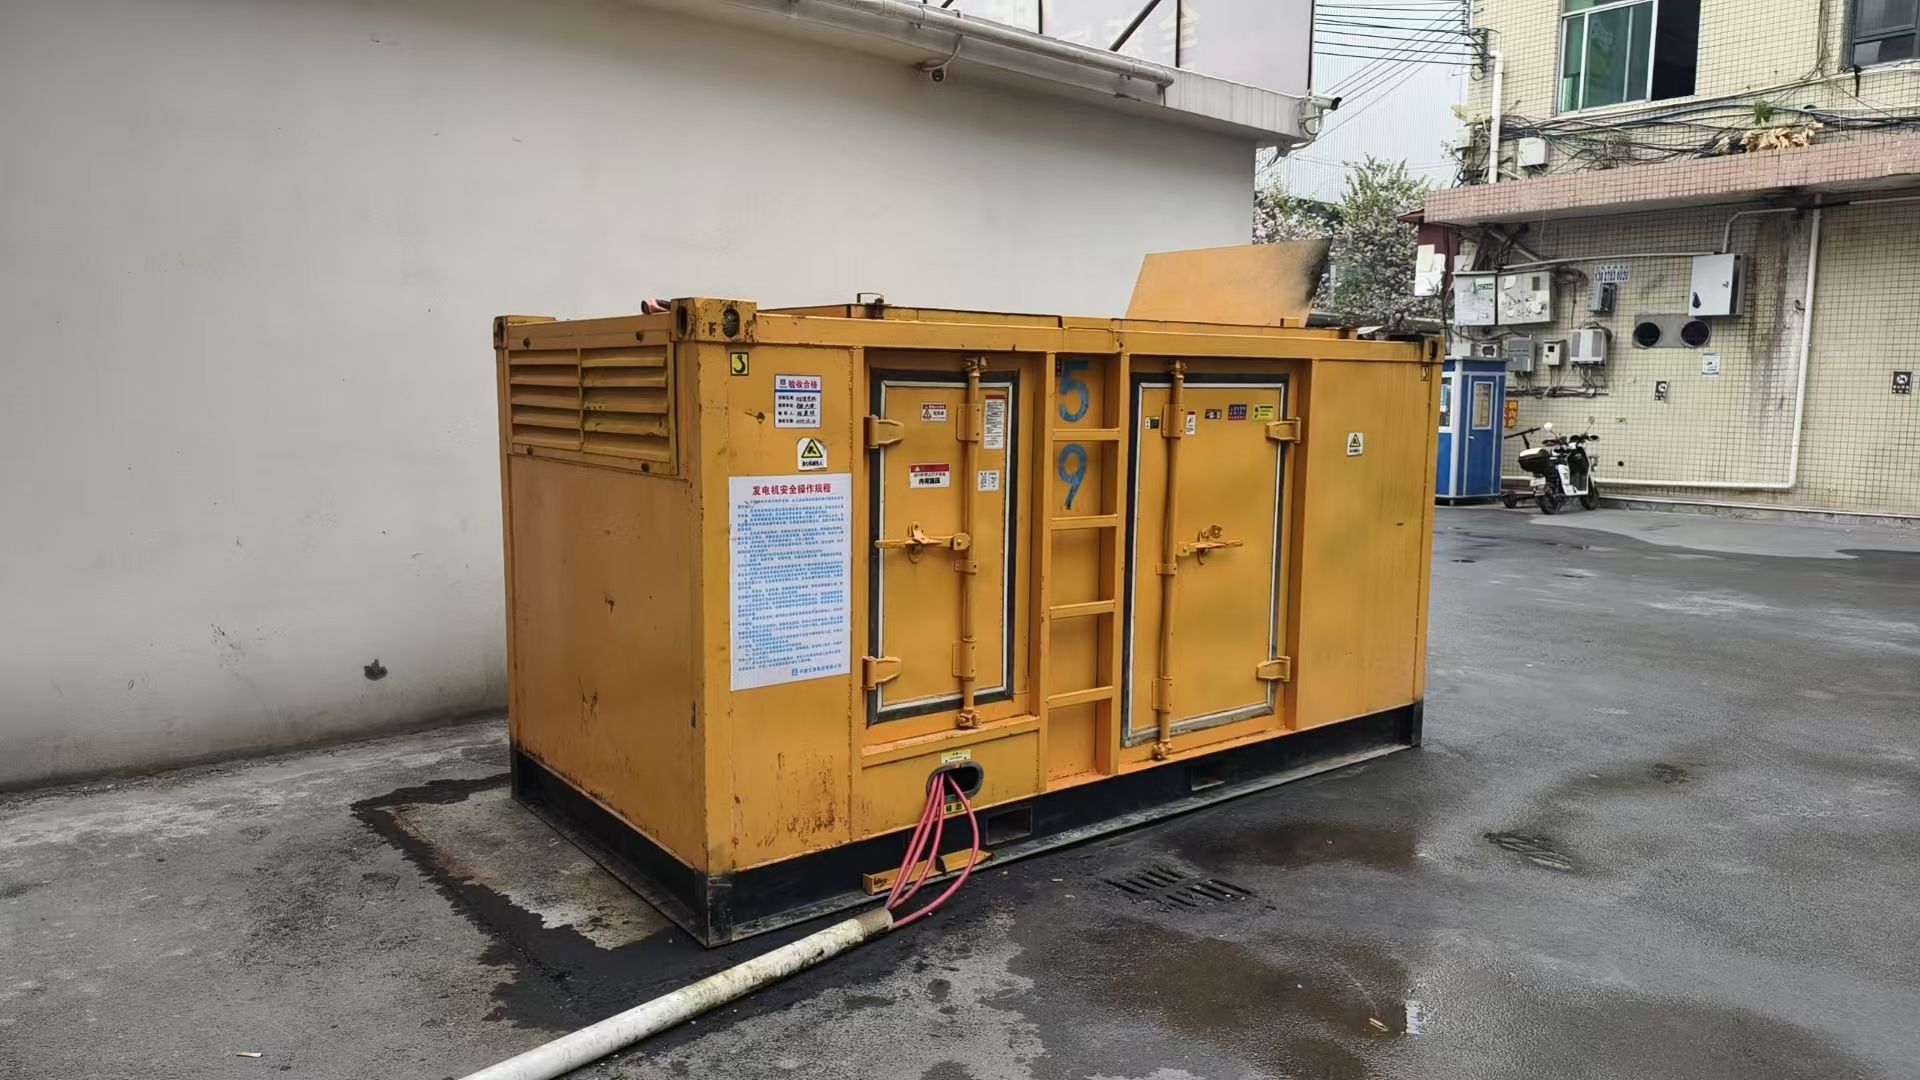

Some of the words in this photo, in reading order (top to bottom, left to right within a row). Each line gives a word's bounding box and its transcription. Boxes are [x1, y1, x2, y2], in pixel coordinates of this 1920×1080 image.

[788, 379, 818, 389] 验收合格
[1060, 361, 1090, 423] 5
[752, 483, 832, 496] 发电机安全操作规程
[1058, 443, 1088, 511] 9
